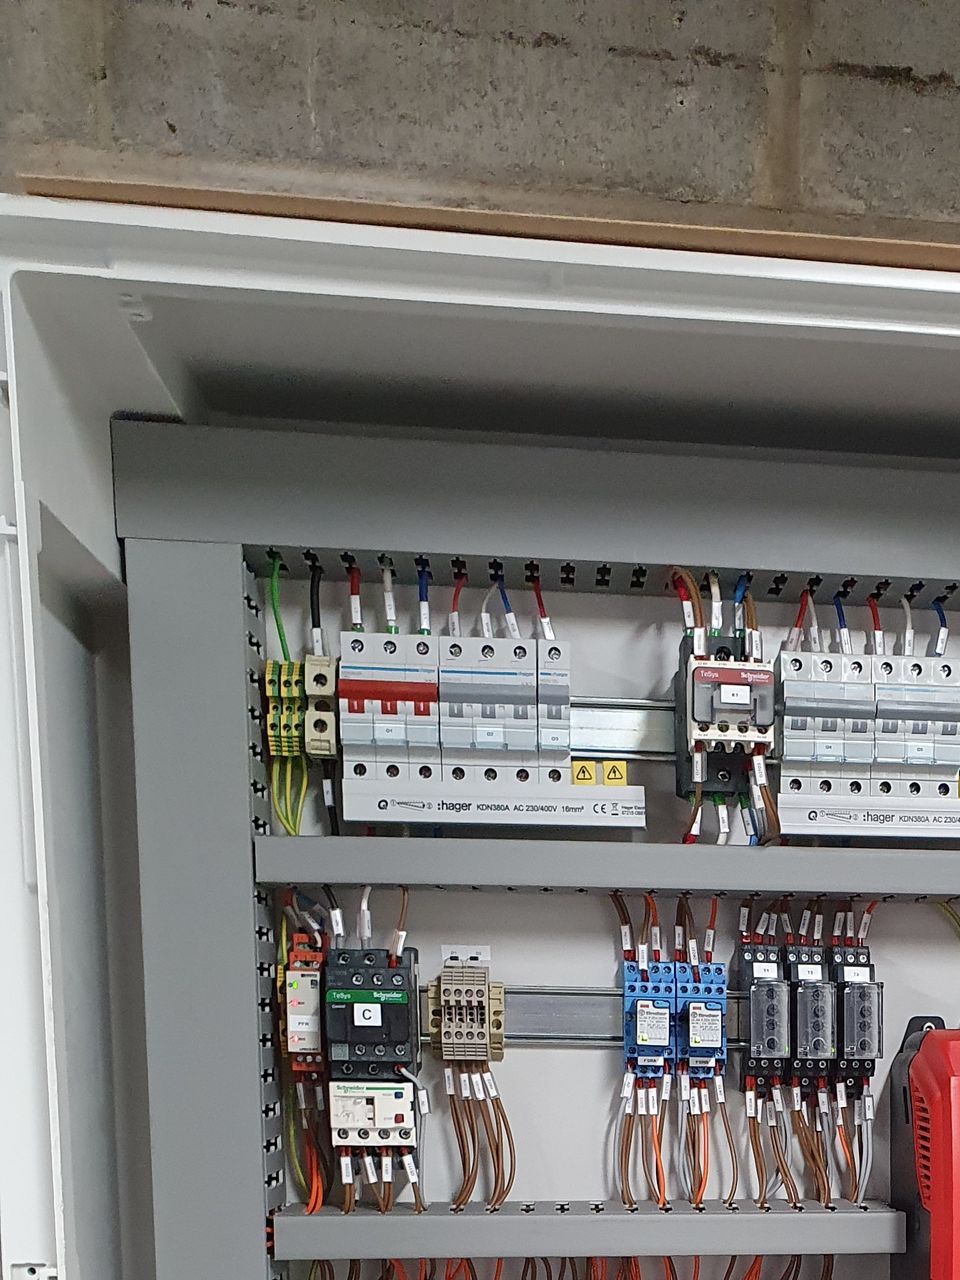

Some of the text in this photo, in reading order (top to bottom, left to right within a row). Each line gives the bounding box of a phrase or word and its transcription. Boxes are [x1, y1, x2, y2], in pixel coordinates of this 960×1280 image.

[741, 672, 770, 682] Schneider
[373, 992, 402, 1001] Schneider
[362, 1009, 372, 1020] C
[336, 1085, 365, 1094] Schneider
